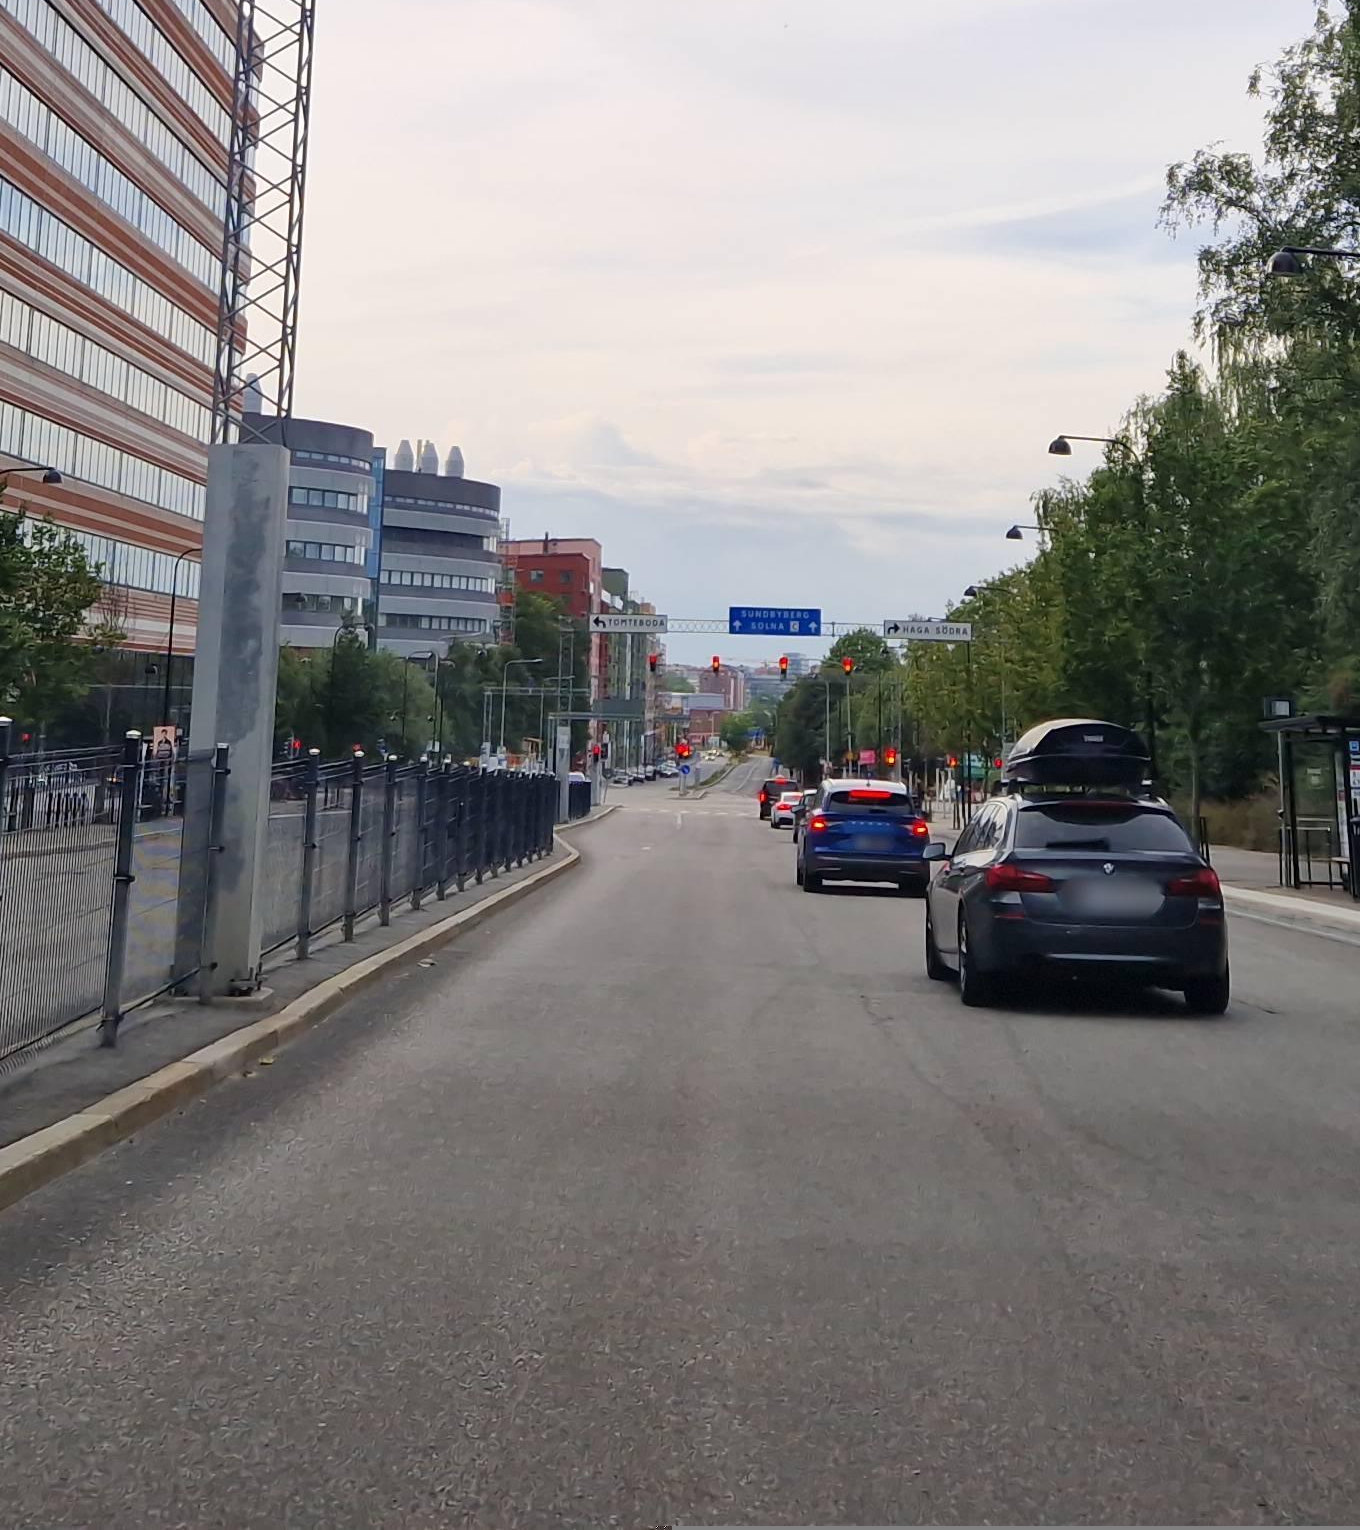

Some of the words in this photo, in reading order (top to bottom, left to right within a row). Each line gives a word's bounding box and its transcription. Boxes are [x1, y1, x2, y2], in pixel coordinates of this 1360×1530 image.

[741, 610, 810, 619] SUNDBYBERG
[608, 618, 665, 627] TOMTEBODA
[751, 621, 784, 630] SOLNA
[903, 625, 930, 635] HAGA
[936, 625, 968, 636] SÖDRA
